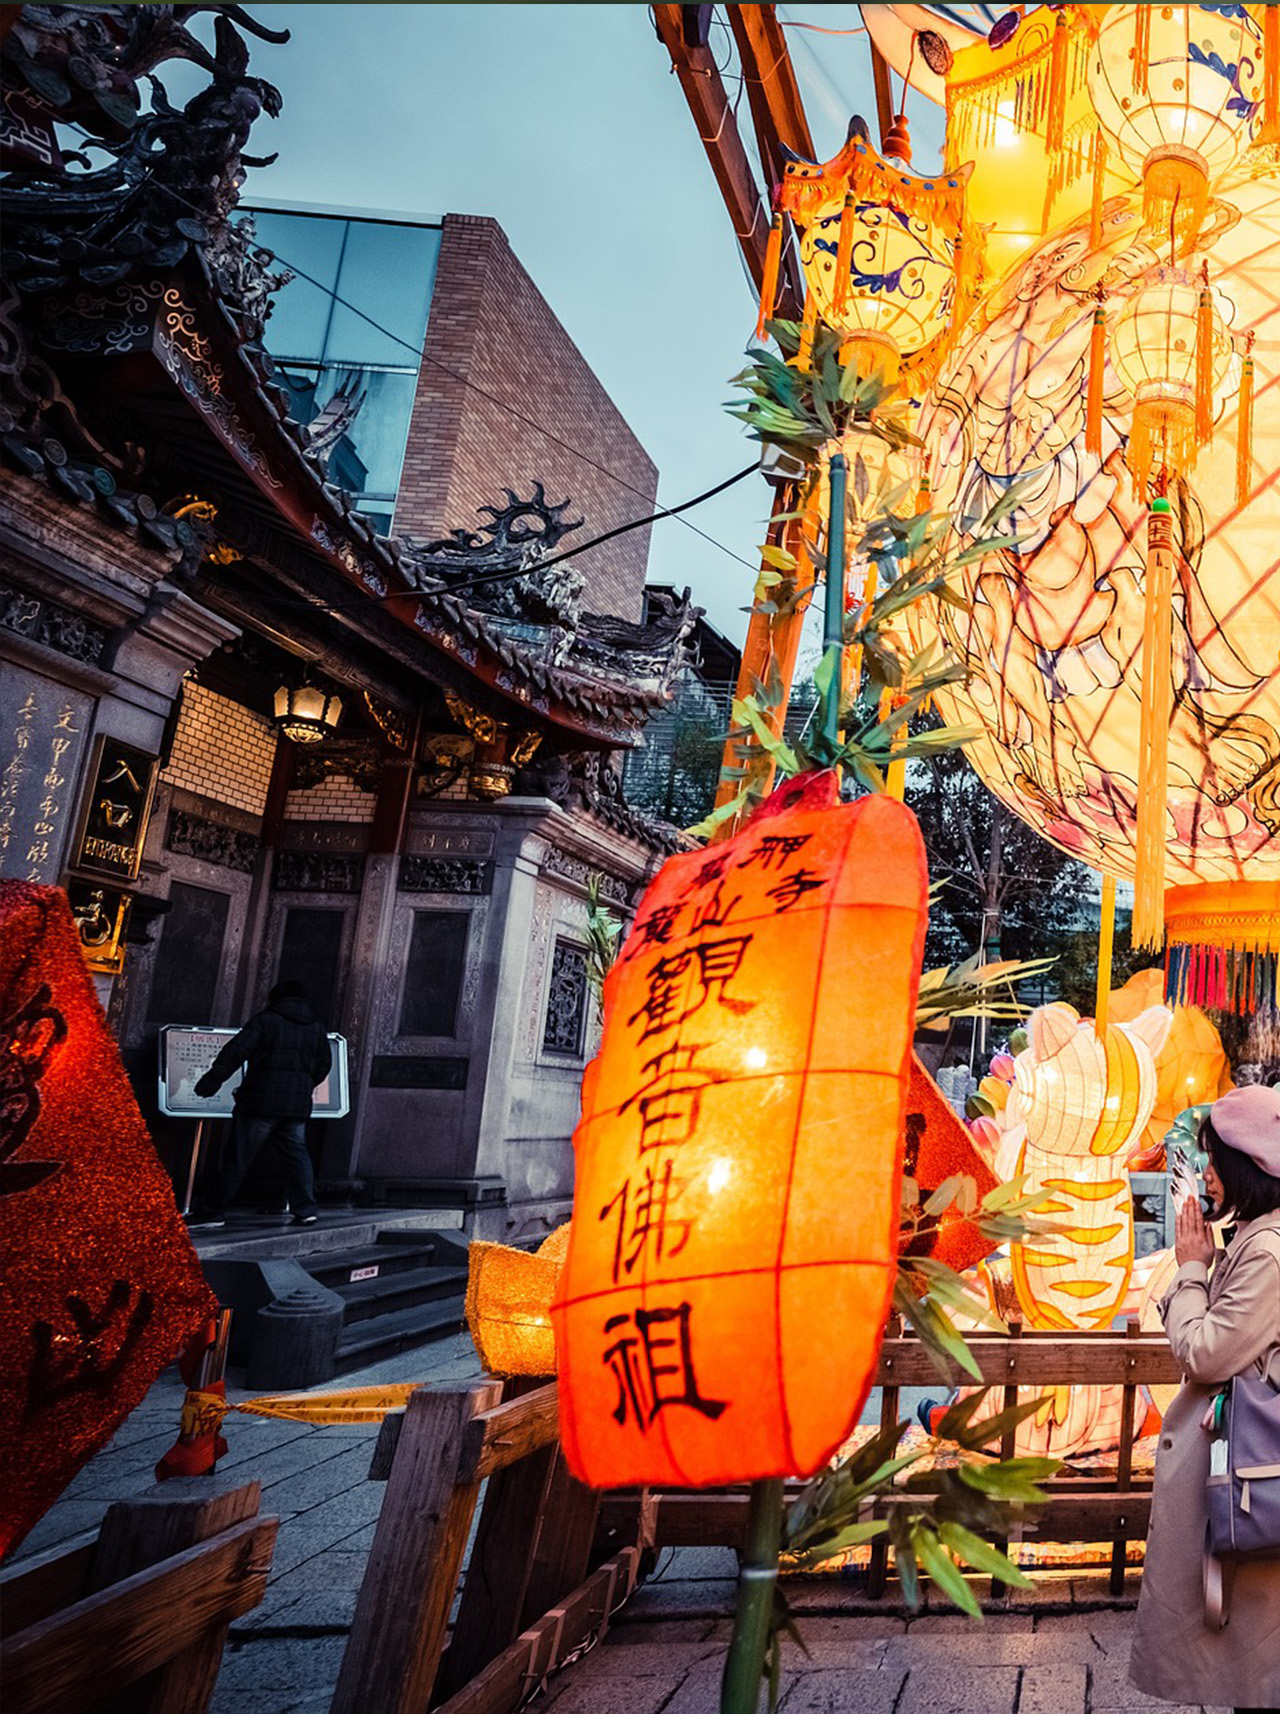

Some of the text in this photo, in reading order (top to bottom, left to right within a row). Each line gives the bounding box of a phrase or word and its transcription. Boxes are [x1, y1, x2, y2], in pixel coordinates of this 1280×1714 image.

[100, 759, 141, 828] 入口
[624, 868, 829, 961] 龍山寺
[599, 933, 754, 1435] 觀音佛祖
